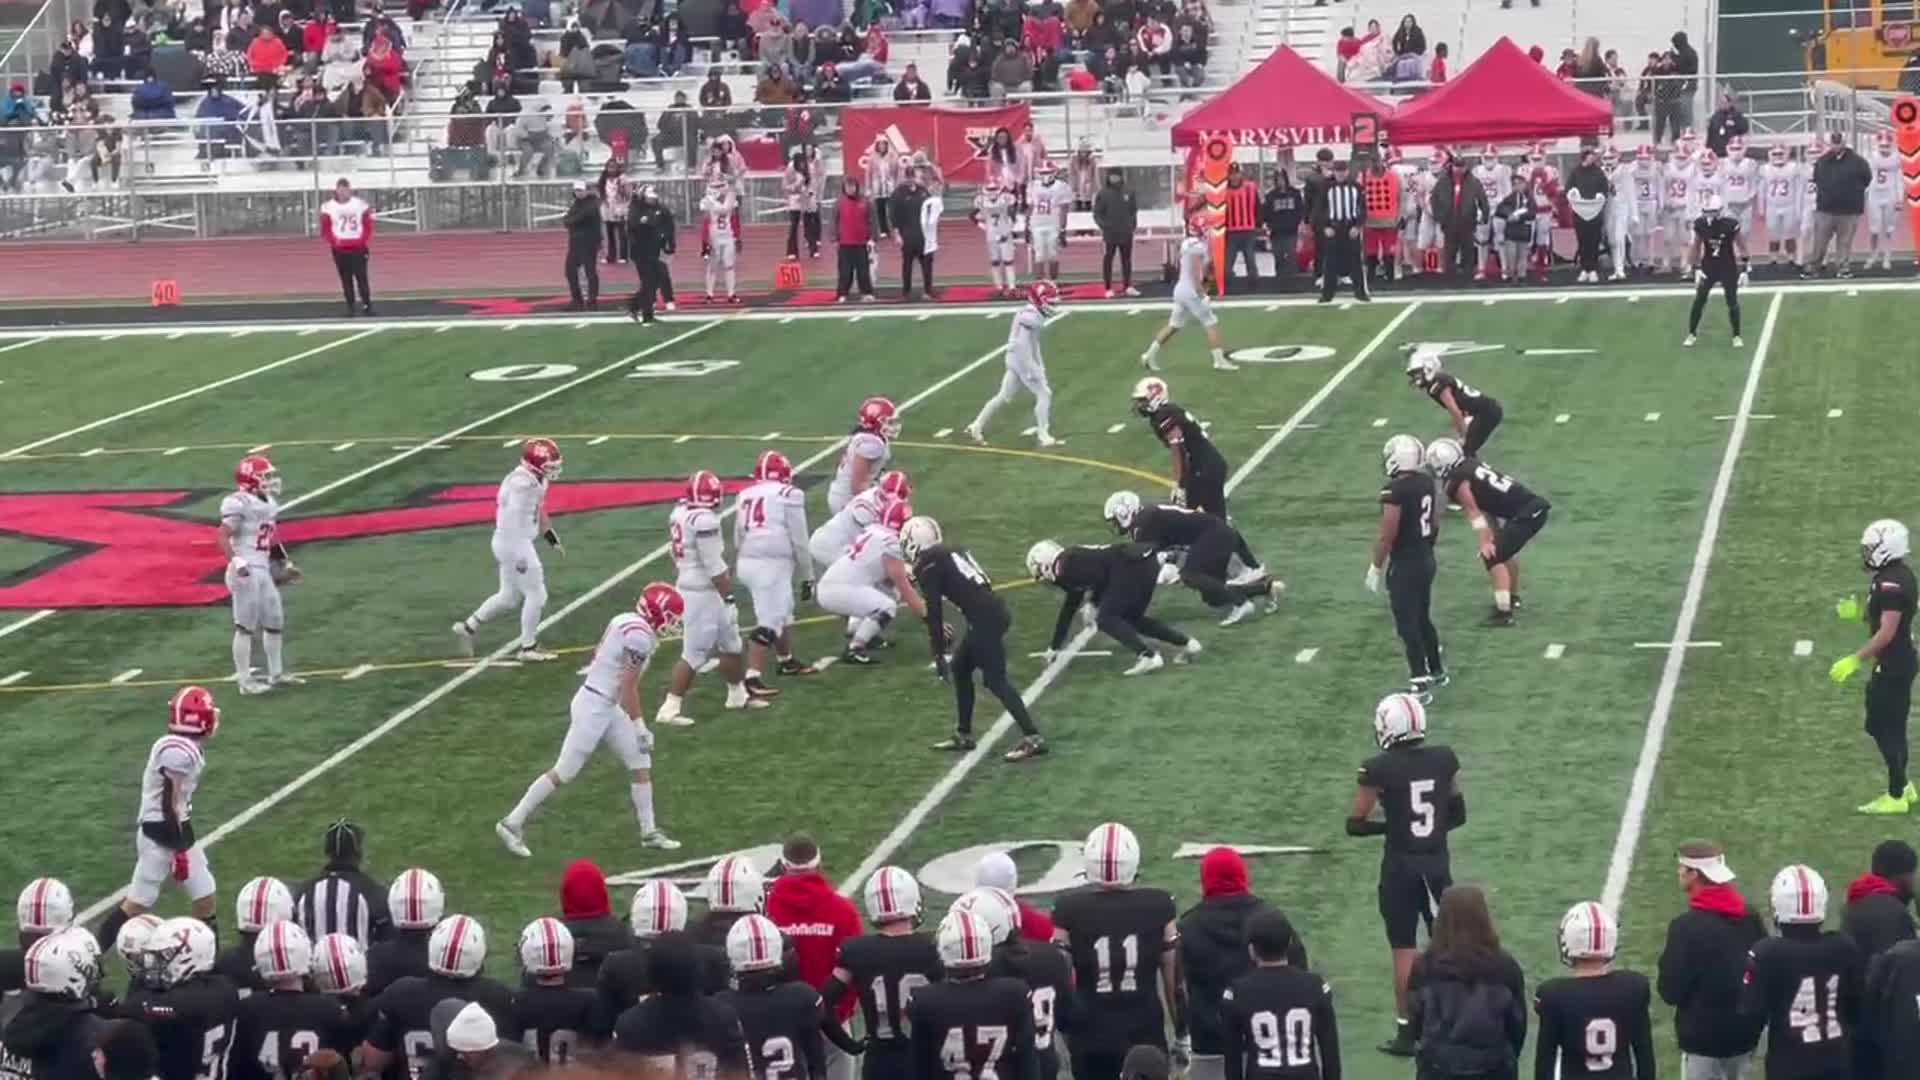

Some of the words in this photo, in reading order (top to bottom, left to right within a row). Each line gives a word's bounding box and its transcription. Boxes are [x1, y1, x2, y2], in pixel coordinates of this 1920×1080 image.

[1199, 126, 1352, 146] MARYSVILL
[1354, 117, 1375, 143] 2
[1769, 179, 1788, 197] 73
[153, 283, 174, 301] 40
[742, 496, 766, 532] 74
[1410, 779, 1435, 837] 5
[1094, 934, 1139, 993] 11
[1790, 975, 1843, 1043] 41
[940, 1025, 1008, 1080] 47
[1251, 1007, 1312, 1067] 90
[1585, 1018, 1617, 1072] 9
